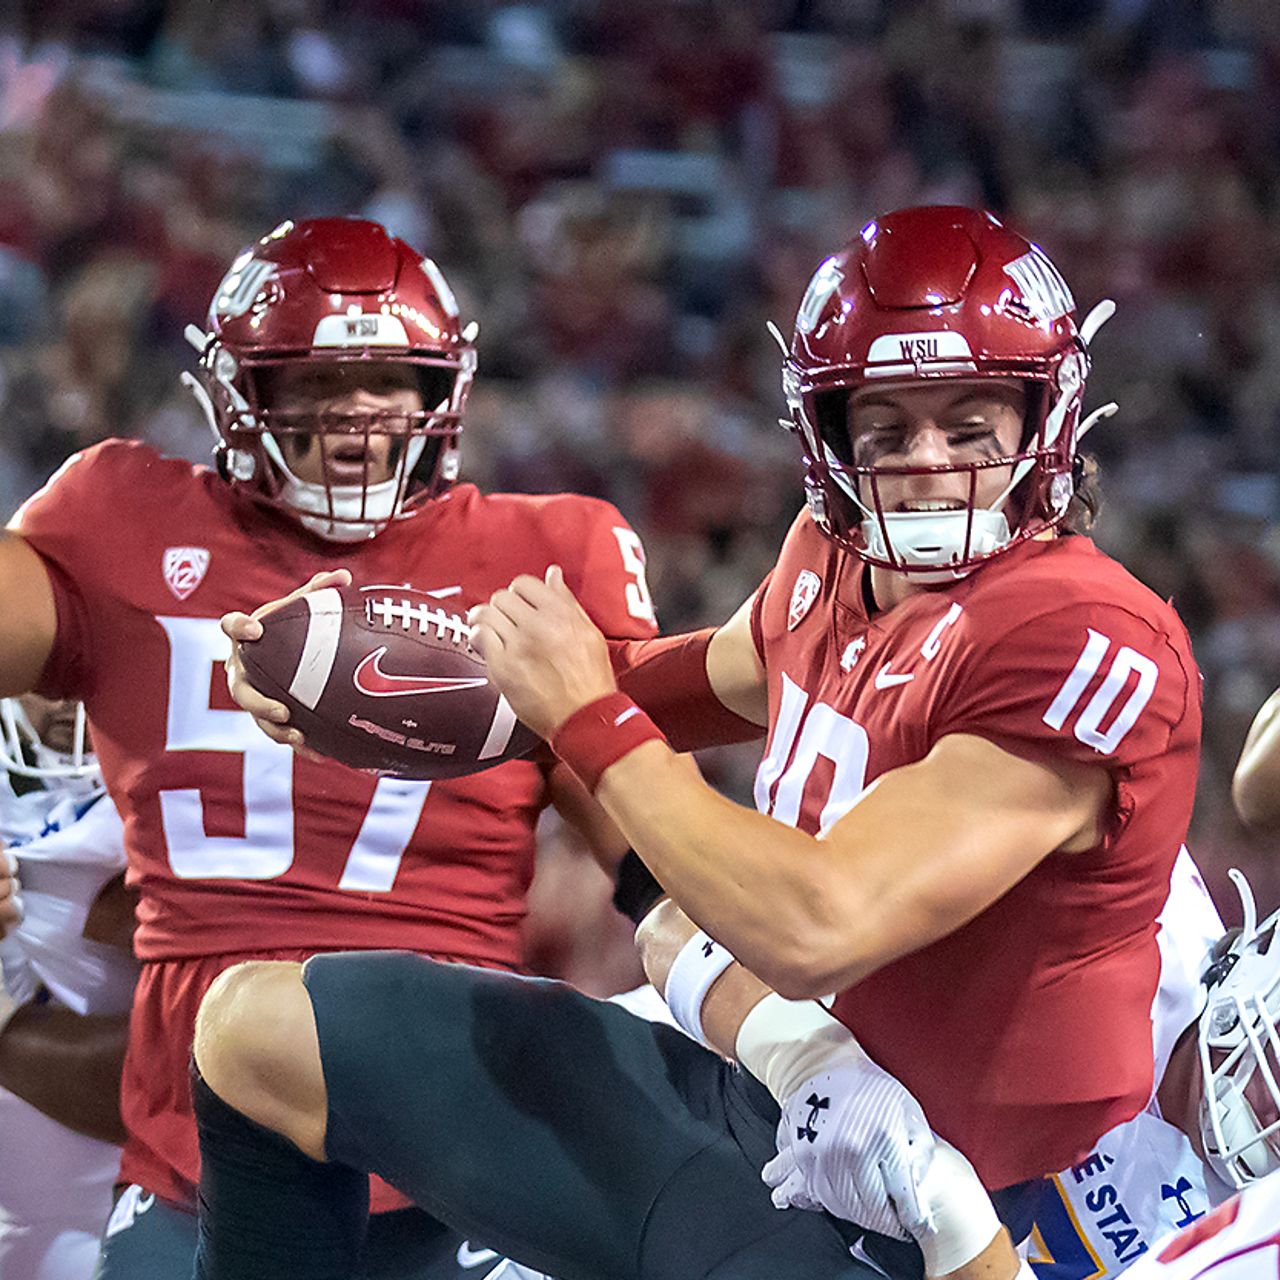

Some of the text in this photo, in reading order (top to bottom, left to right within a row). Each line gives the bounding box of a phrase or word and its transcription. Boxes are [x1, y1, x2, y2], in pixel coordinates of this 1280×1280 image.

[344, 318, 379, 336] WSU
[899, 338, 938, 361] WSU
[921, 602, 963, 662] C
[1043, 627, 1158, 756] 10
[406, 737, 457, 757] ELITE
[753, 671, 872, 840] 10
[1085, 1184, 1151, 1264] STAT
